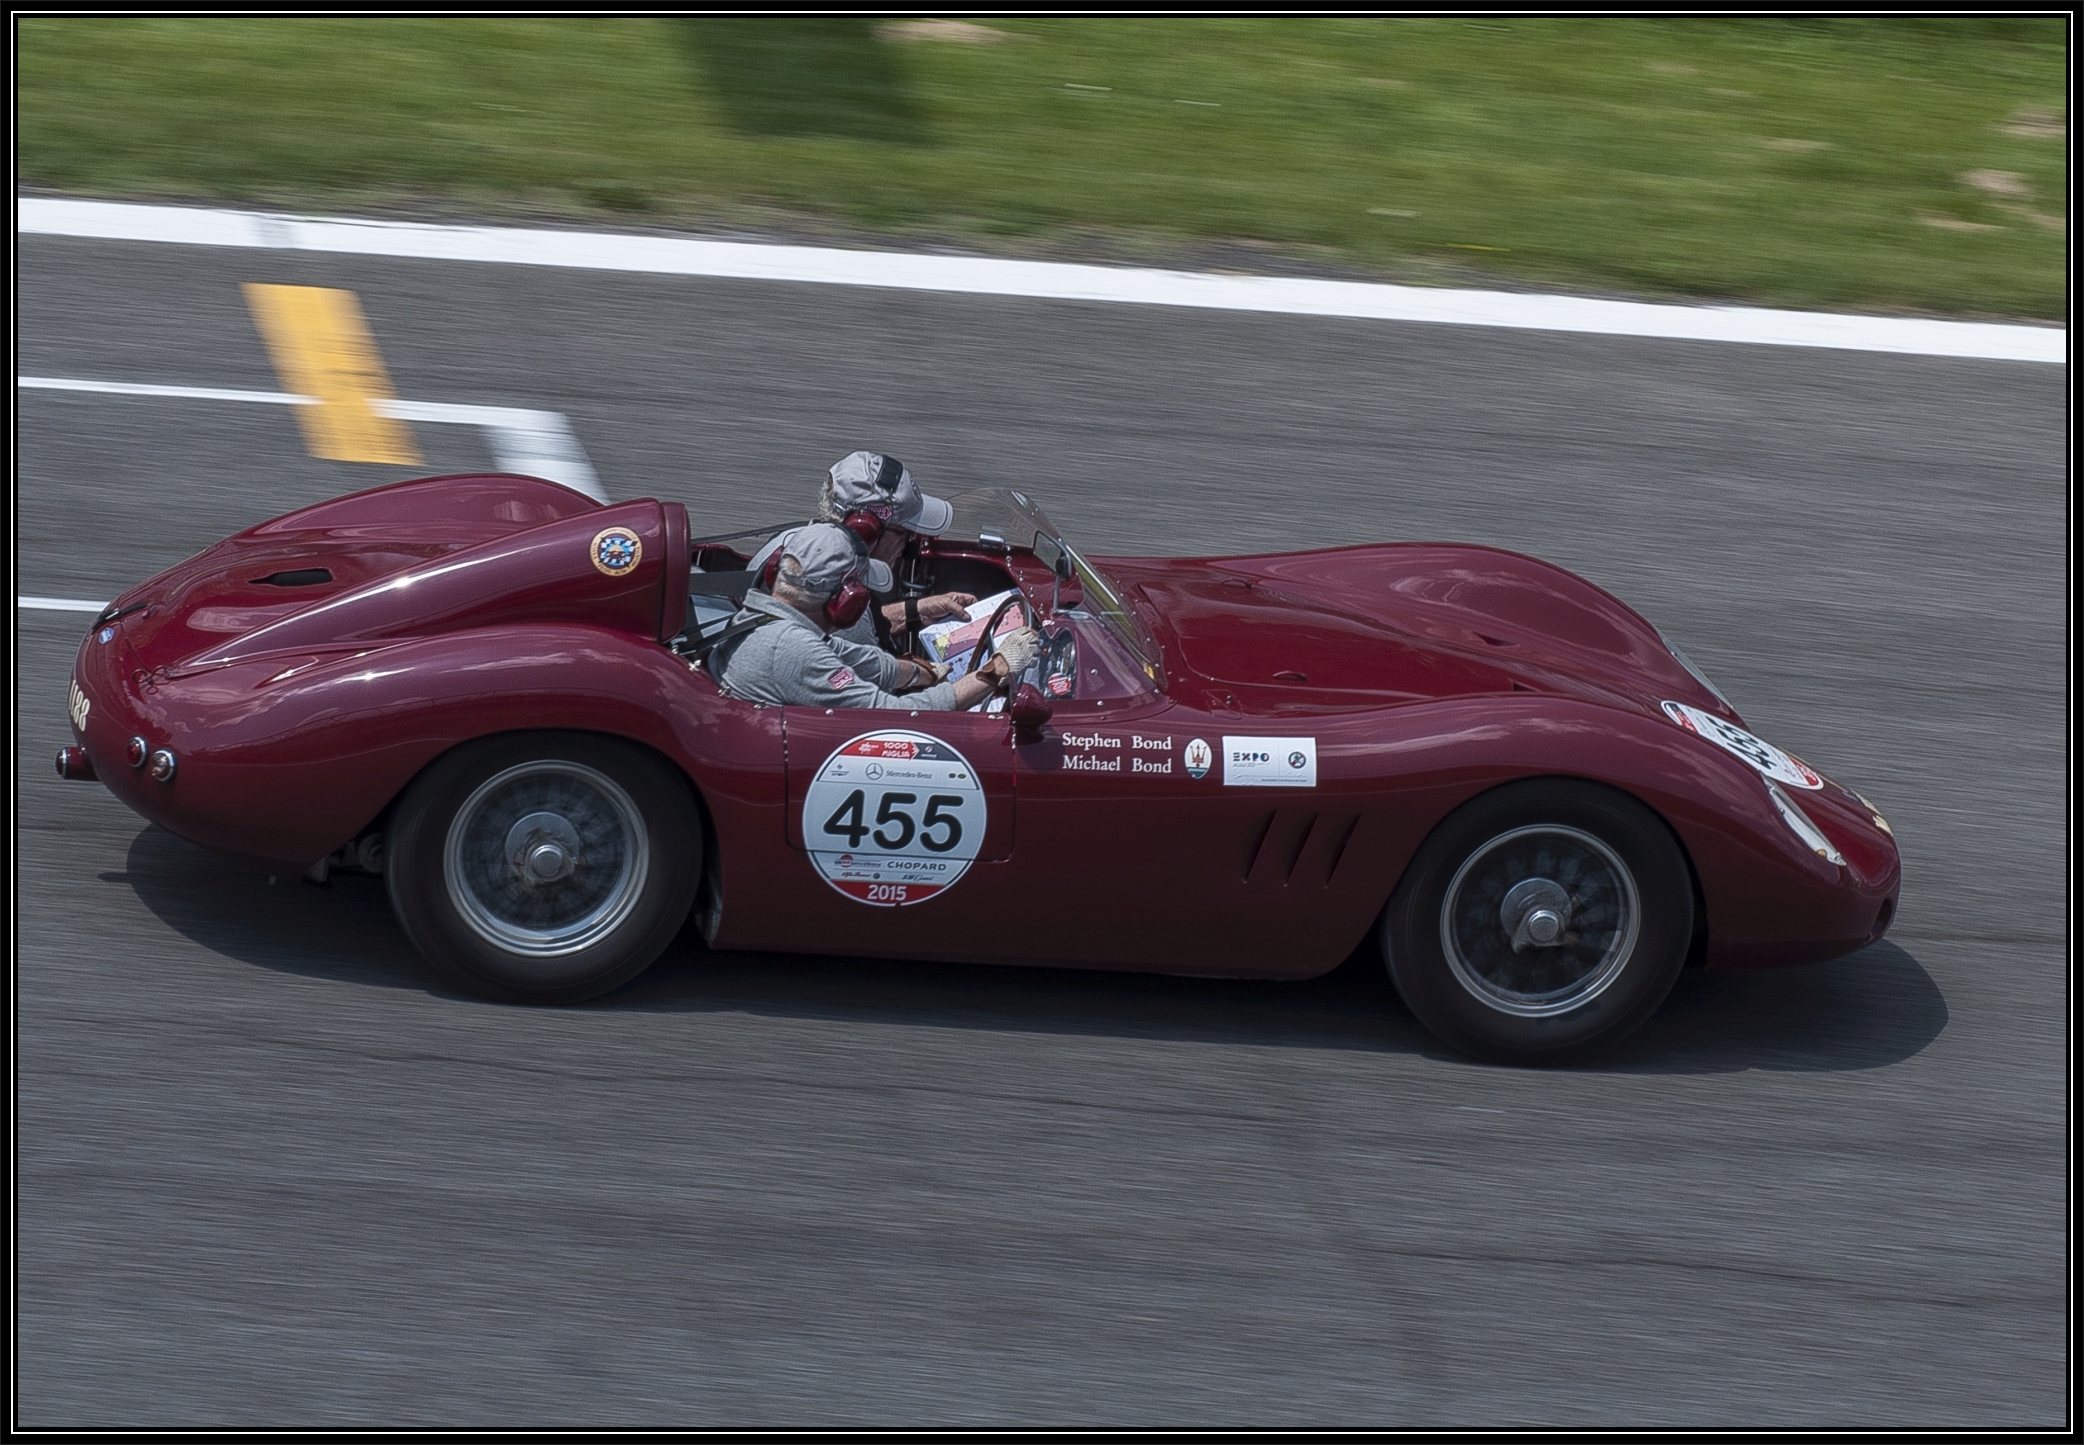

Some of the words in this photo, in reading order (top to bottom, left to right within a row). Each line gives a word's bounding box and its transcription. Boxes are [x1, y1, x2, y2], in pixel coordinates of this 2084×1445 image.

[883, 741, 909, 750] 1000
[1061, 732, 1121, 751] Stephen
[1131, 735, 1173, 750] Bond
[1705, 717, 1778, 770] 455
[881, 750, 911, 758] MIGLIA
[1232, 752, 1270, 762] EXPO
[1061, 754, 1121, 772] Michael
[1131, 757, 1173, 773] Bond
[823, 789, 964, 852] 455
[887, 861, 947, 871] CHOPARD
[867, 884, 907, 901] 2015
